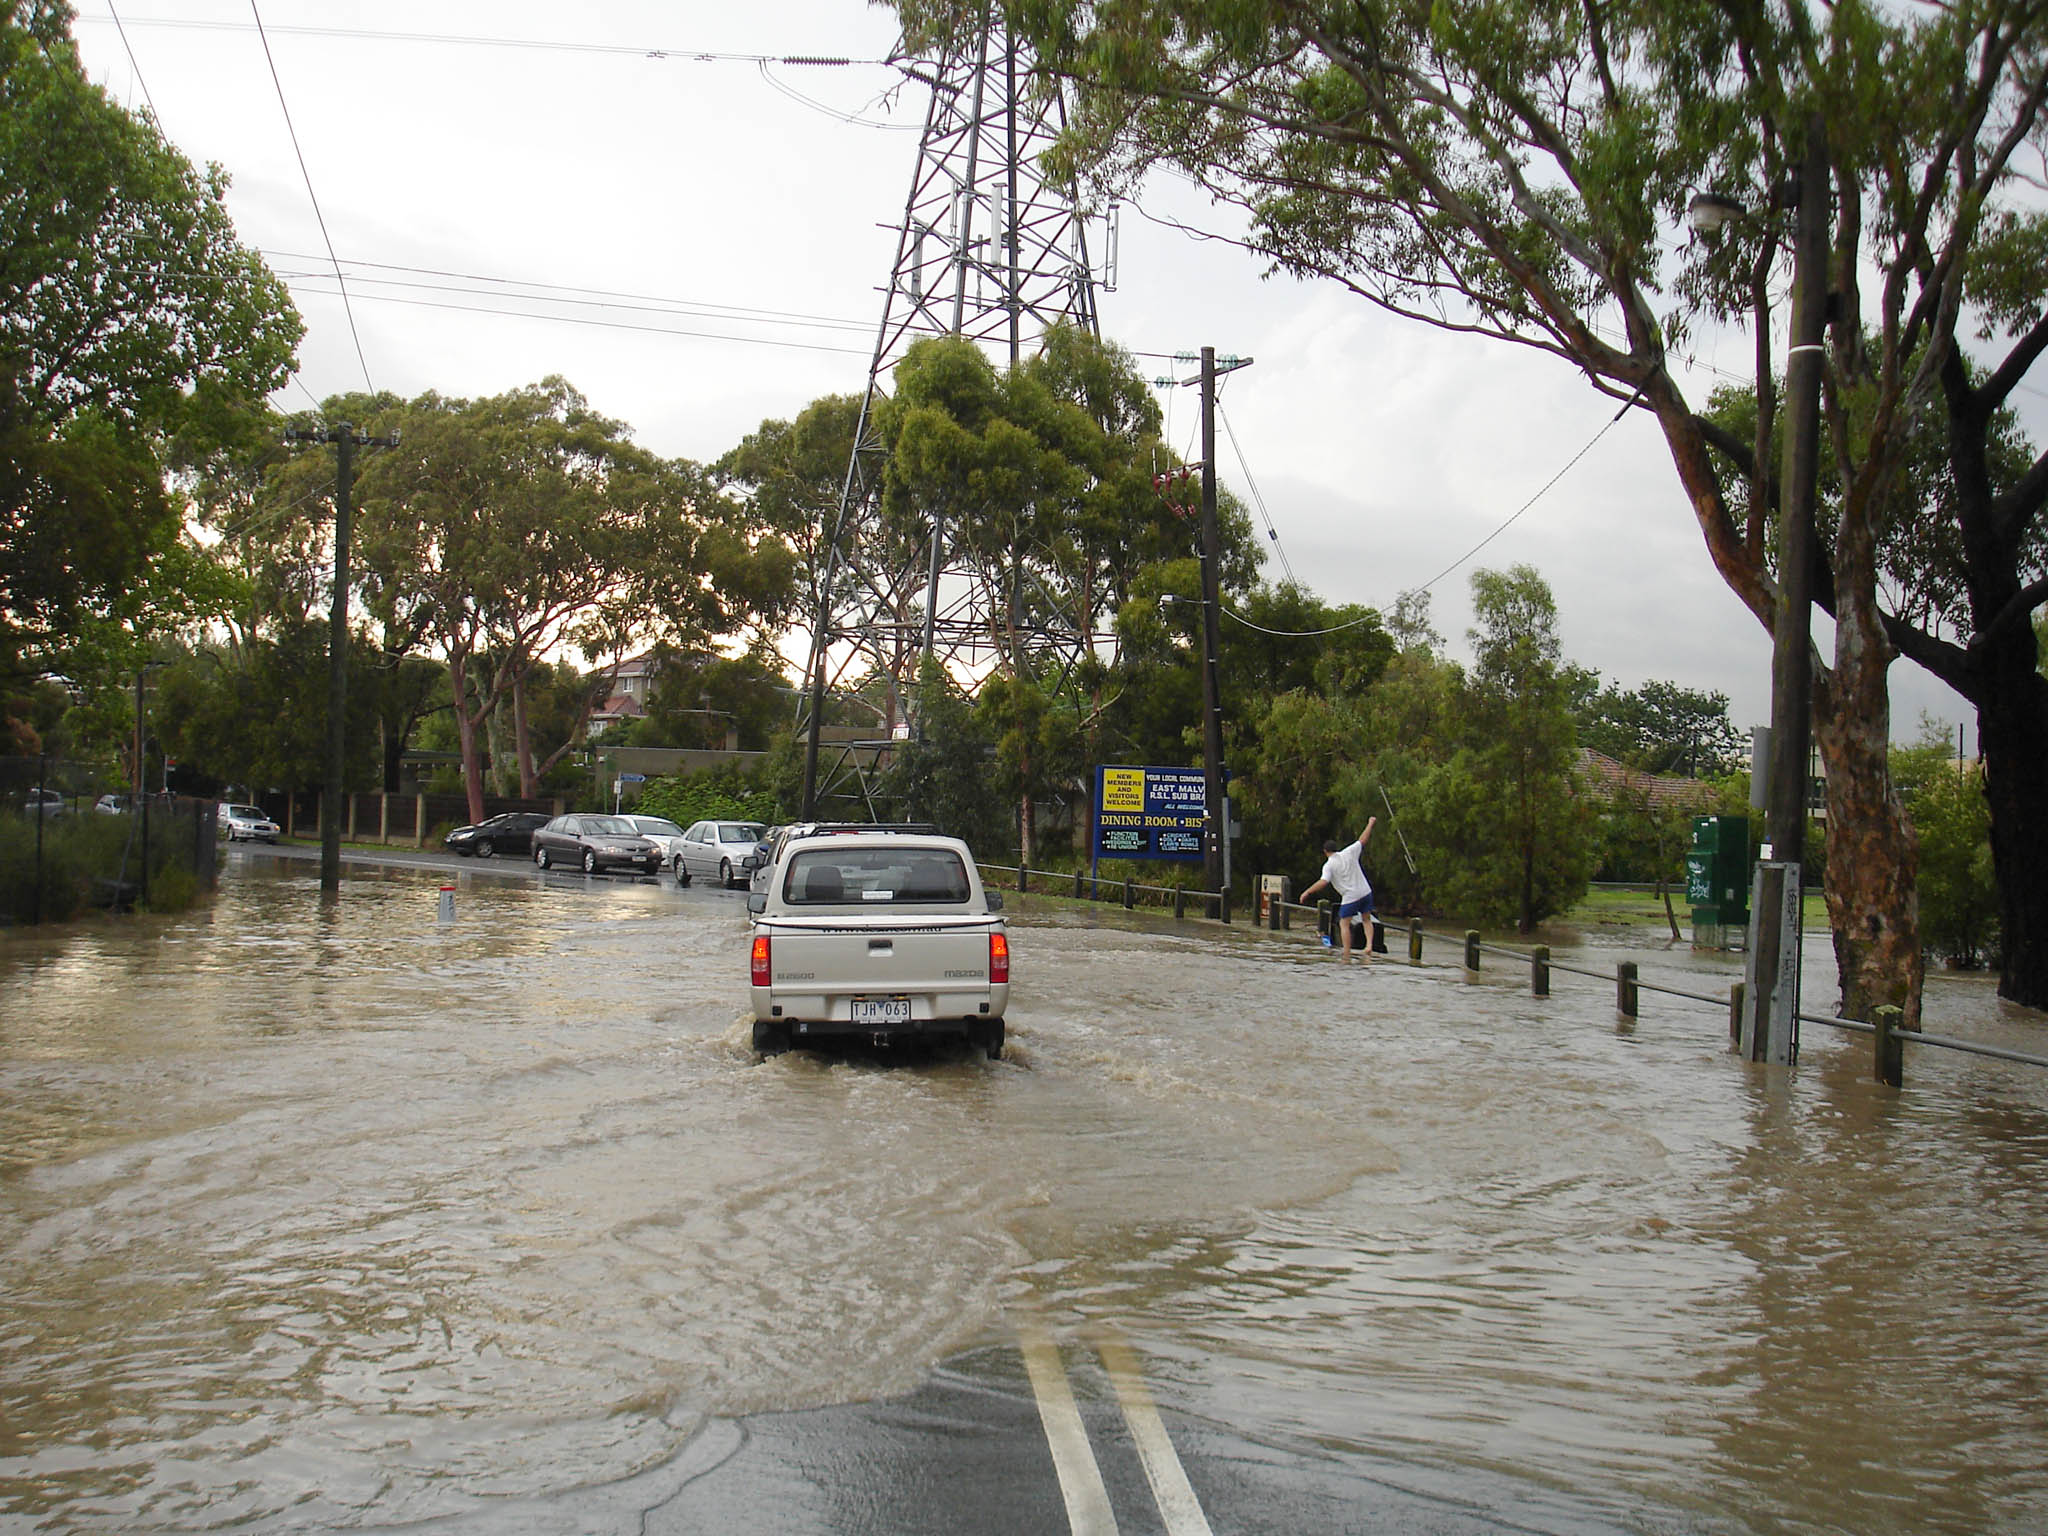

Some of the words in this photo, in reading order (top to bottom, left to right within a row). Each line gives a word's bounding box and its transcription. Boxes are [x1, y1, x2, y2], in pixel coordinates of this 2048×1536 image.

[1152, 784, 1175, 792] EAST
[1172, 792, 1188, 800] SUB
[1101, 815, 1141, 826] DINING
[1144, 816, 1177, 827] ROOM
[854, 1003, 876, 1016] TJH
[885, 1003, 908, 1016] 063
